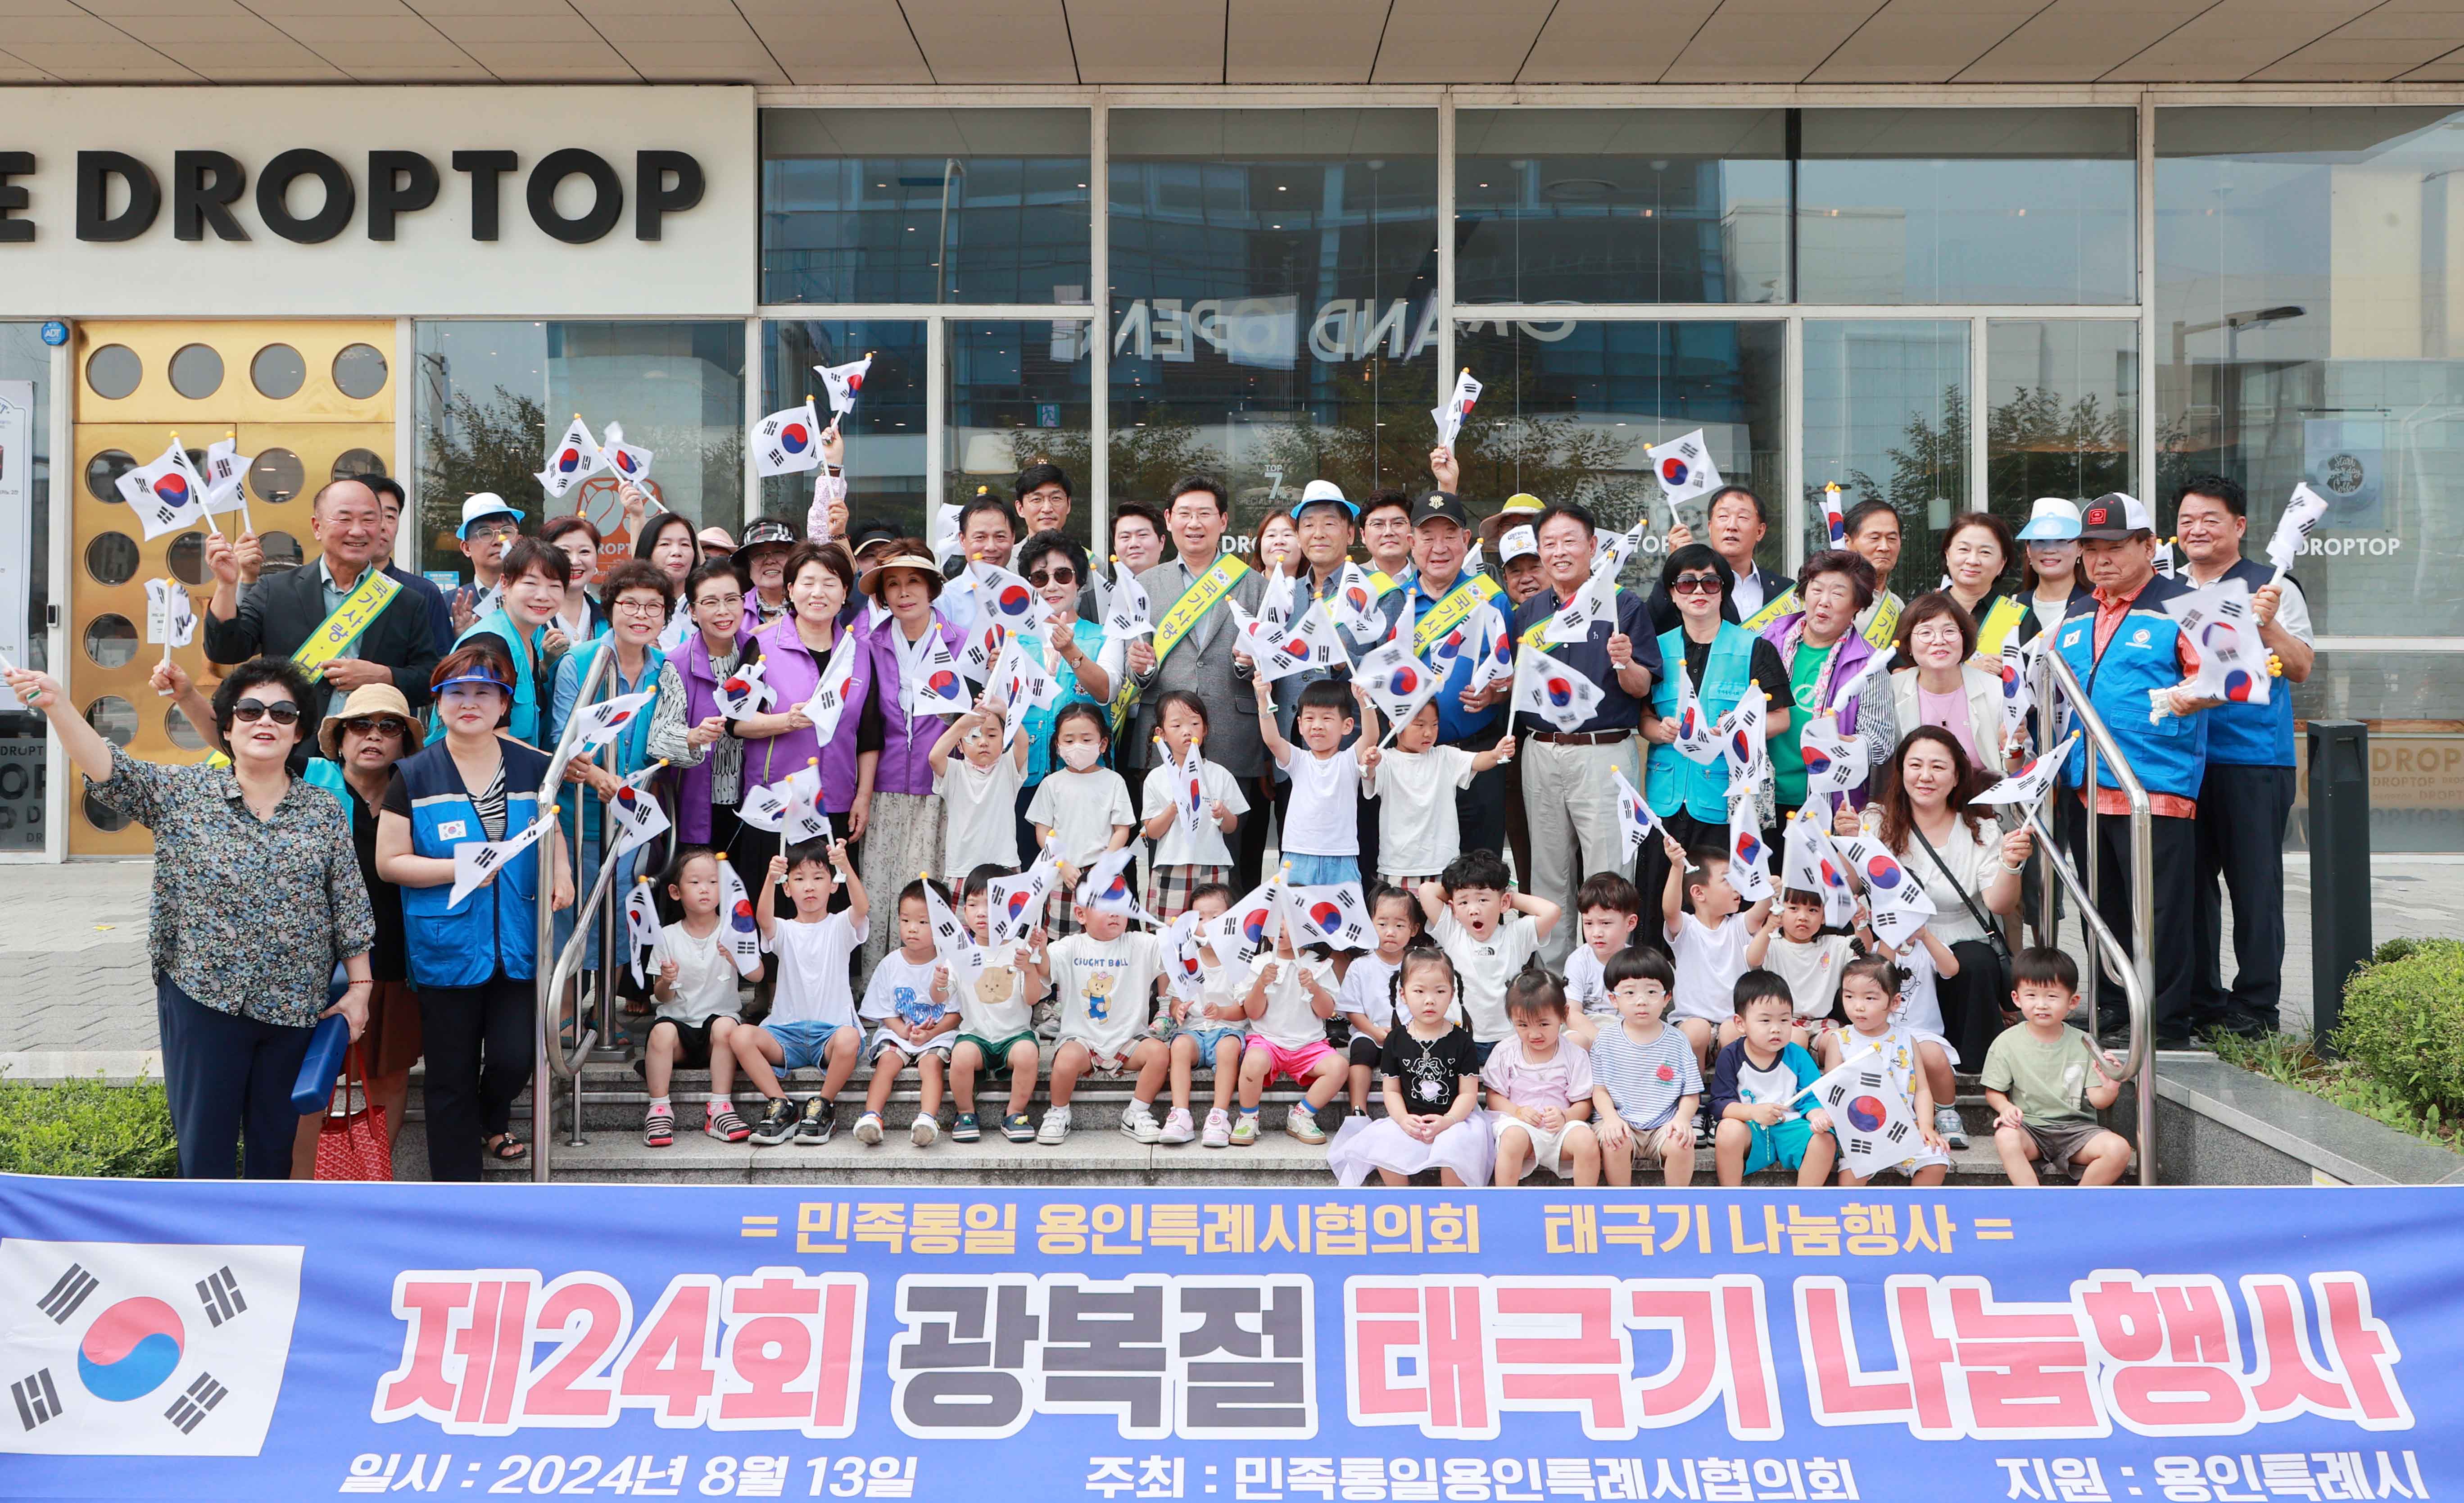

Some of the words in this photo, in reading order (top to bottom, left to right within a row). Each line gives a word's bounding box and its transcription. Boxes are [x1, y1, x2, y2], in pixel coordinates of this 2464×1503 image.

[77, 147, 707, 245] DROPTOP
[45, 329, 61, 337] ADT
[1163, 581, 1218, 640] 국기사랑
[2373, 777, 2435, 786] DROPTOP
[796, 1203, 1017, 1254] 민족통일
[1036, 1203, 1480, 1255] 용인특례시협의회
[1545, 1205, 1712, 1256] 태극기
[1729, 1203, 1957, 1256] 나눔행사
[383, 1278, 856, 1427] 제24회
[900, 1284, 1309, 1429] 광복절
[1355, 1285, 1771, 1429] 태극기
[1805, 1281, 2400, 1429] 나눔행사
[338, 1453, 453, 1494] 일시
[487, 1454, 688, 1496] 2024년
[698, 1455, 789, 1498] 8월
[805, 1456, 918, 1498] 13일
[1085, 1454, 1186, 1500] 주최
[1235, 1456, 1861, 1502] 민족통일용인특례시협의회
[1995, 1457, 2113, 1503] 지원
[2153, 1450, 2431, 1502] 용인특례시
